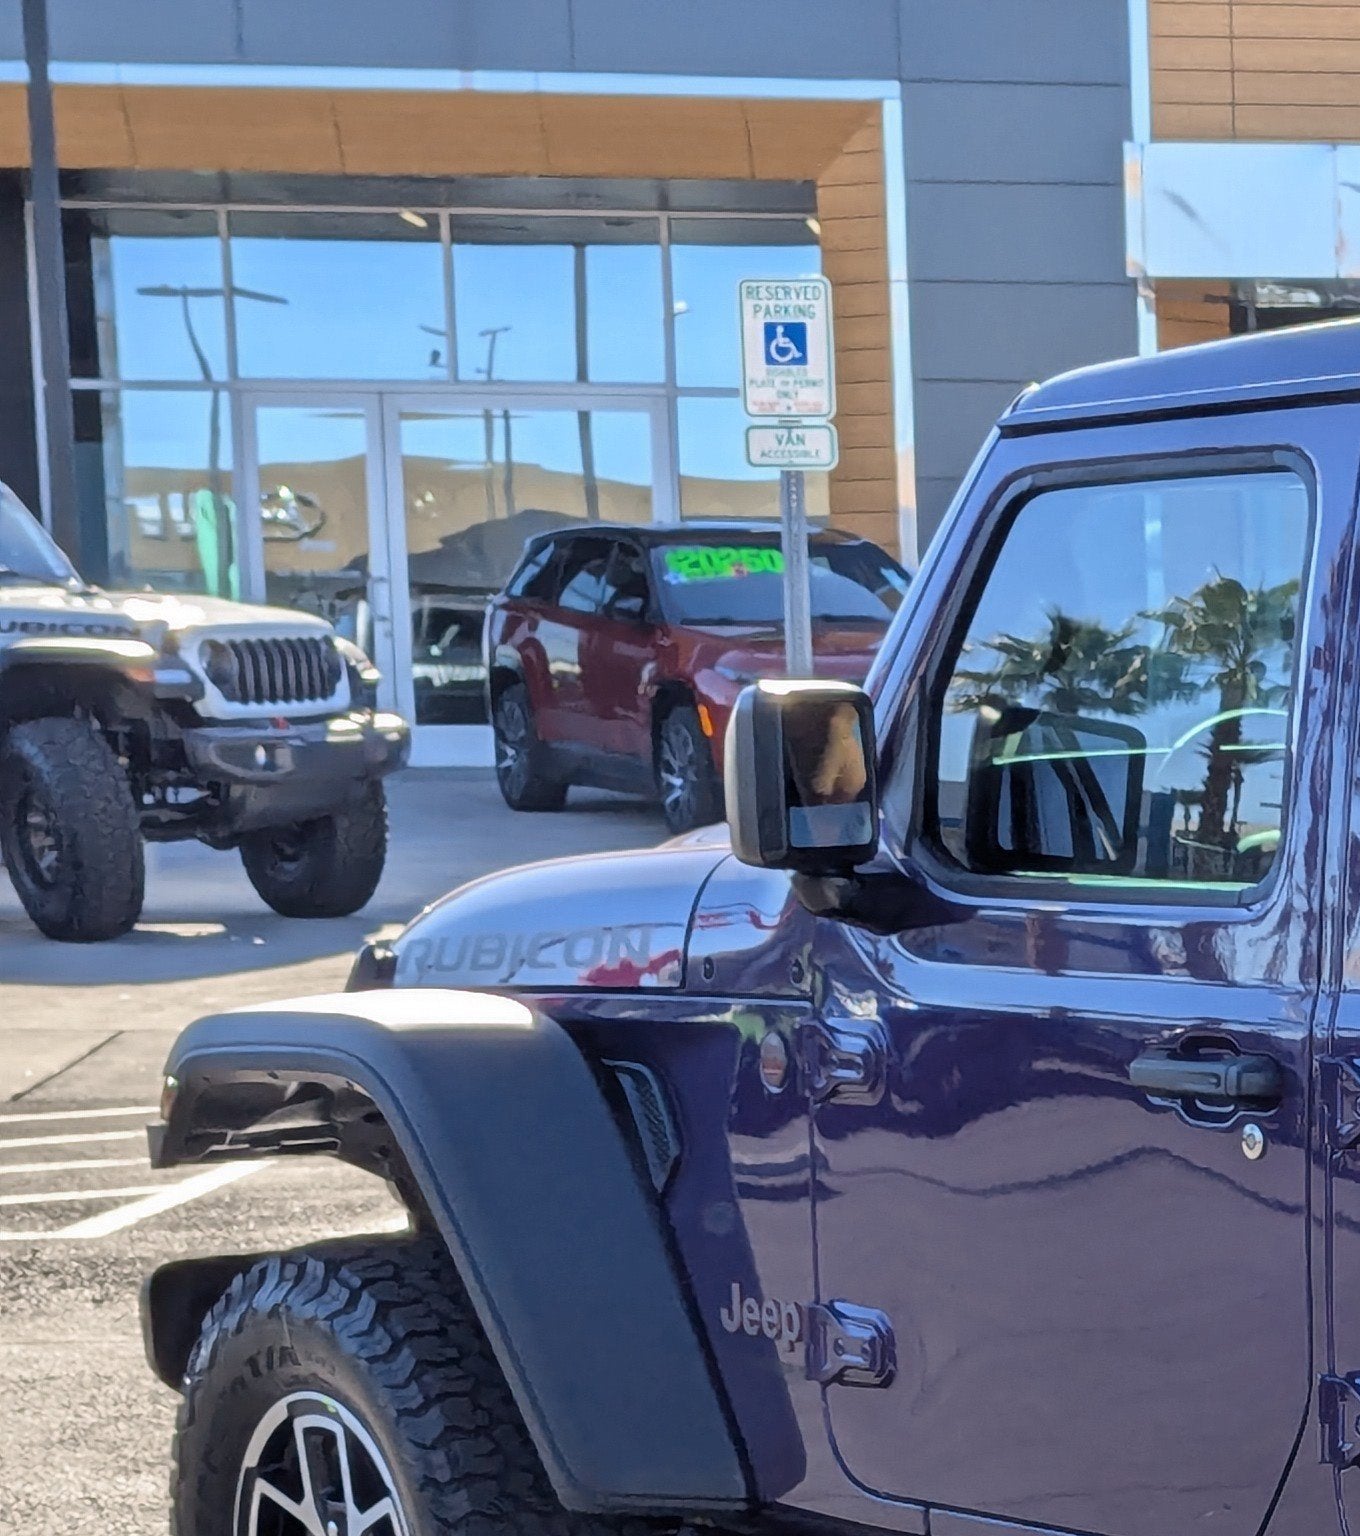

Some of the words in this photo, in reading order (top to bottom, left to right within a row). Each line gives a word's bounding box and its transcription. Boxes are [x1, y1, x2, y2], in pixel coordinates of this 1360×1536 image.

[746, 285, 821, 300] RESERVED
[753, 304, 816, 319] PARKING
[776, 434, 805, 446] VAN
[760, 450, 819, 459] ACCESSIBLE
[399, 927, 652, 983] RUBICON
[720, 1283, 801, 1352] Jeep
